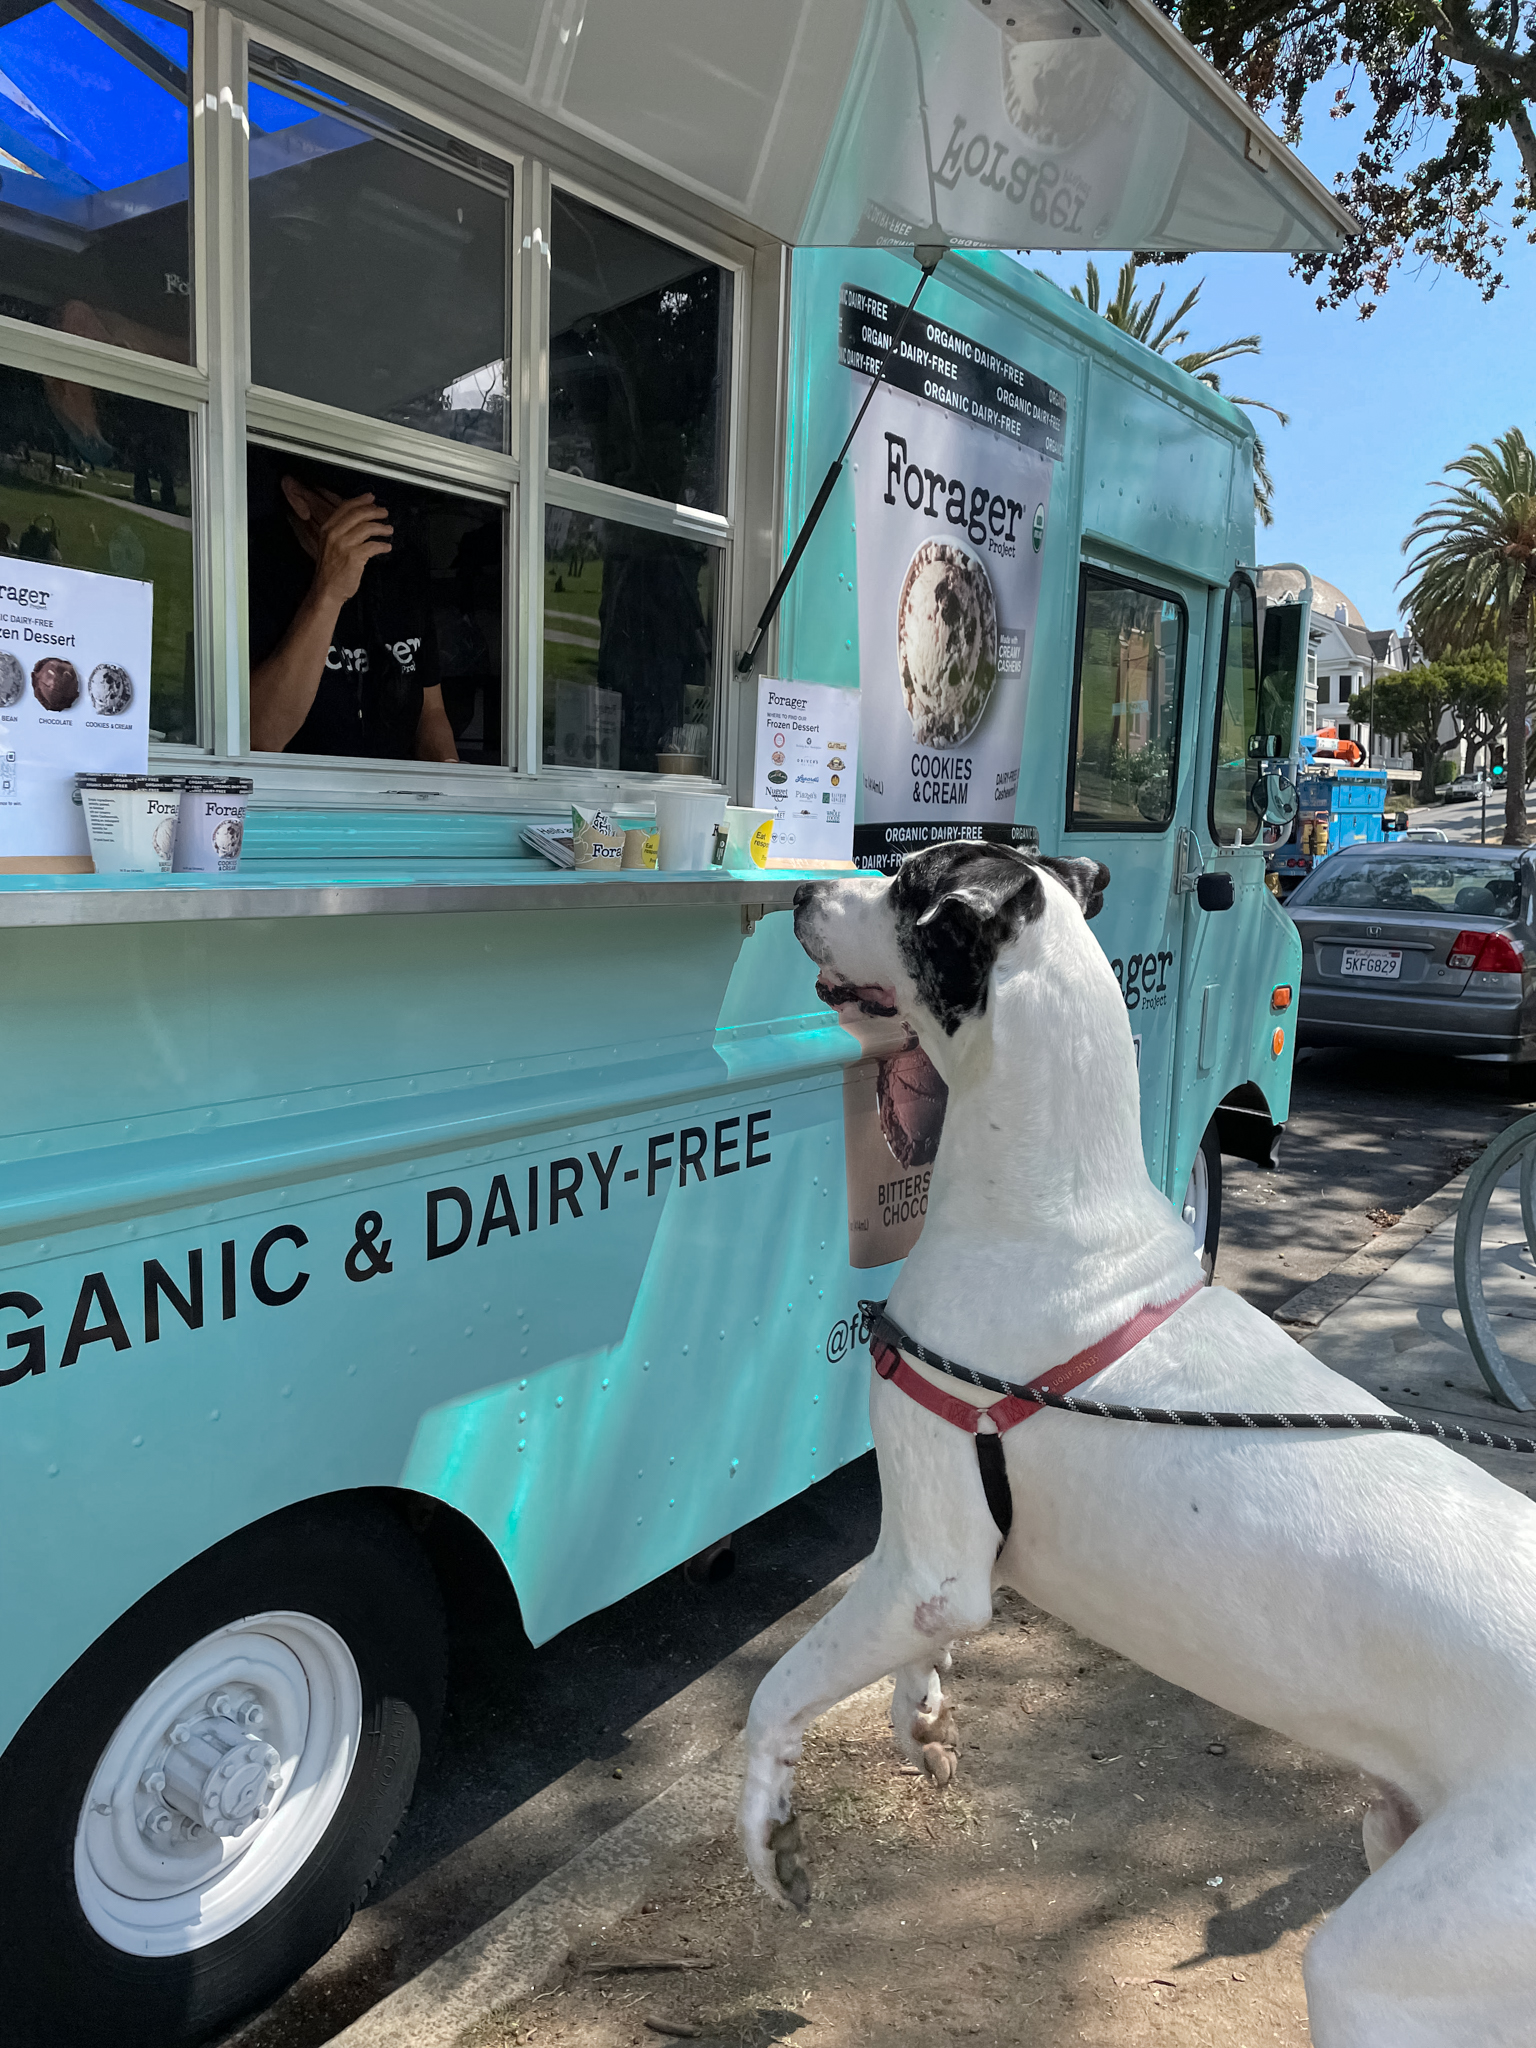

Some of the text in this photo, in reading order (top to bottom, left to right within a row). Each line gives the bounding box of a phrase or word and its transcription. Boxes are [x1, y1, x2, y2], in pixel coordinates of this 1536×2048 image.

[848, 291, 888, 321] DAIRY-FREE
[861, 324, 958, 381] ORGANI DAIRY-FREE
[926, 323, 1025, 387] ORGANIC DAIRY-FREE
[923, 379, 1022, 437] ORGANIC DAIRY-FREE
[996, 386, 1061, 432] ORGANIC DAIRY-FREE
[883, 431, 1023, 545] Forager
[988, 538, 1016, 558] Project
[10, 615, 54, 628] DAIRY-FREE
[23, 627, 76, 648] Dessert
[998, 645, 1021, 658] CREAMY
[997, 659, 1022, 672] CASHEWS
[767, 691, 808, 710] Forager
[38, 717, 73, 727] CHOCOLATE
[85, 721, 110, 729] COOKIES
[766, 718, 820, 733] Frozen Dessert
[911, 753, 973, 780] COOKIES
[912, 780, 969, 805] & CREAM
[755, 831, 766, 840] Eat
[885, 826, 983, 842] ORGANIC DAIRY-FREE
[1011, 826, 1033, 840] ORGANIC
[1345, 957, 1397, 974] 5KFG829
[1141, 994, 1168, 1011] Project
[345, 1210, 394, 1283] &
[426, 1109, 773, 1262] DAIRY-FREE
[883, 1194, 929, 1228] CHOCO
